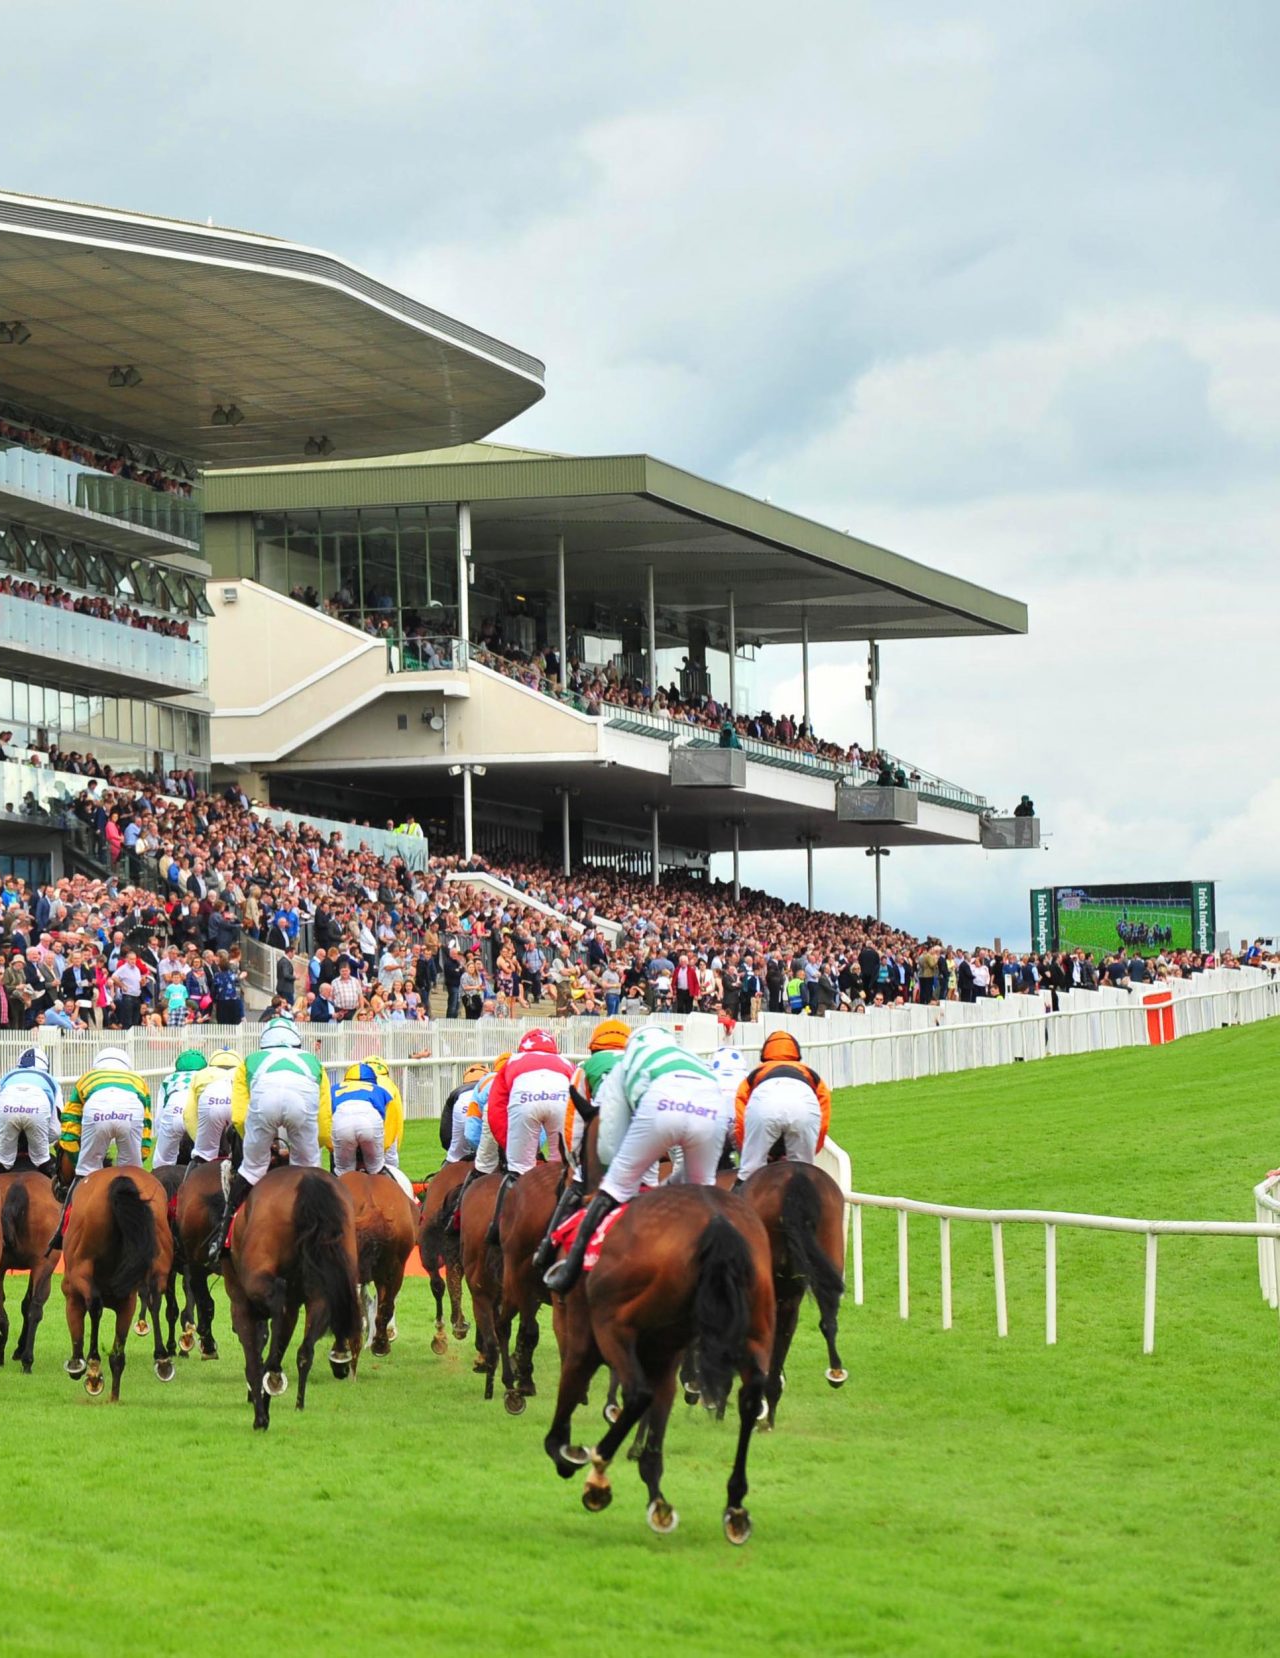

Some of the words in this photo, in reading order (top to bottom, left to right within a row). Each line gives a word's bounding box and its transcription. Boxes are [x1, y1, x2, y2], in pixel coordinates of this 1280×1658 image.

[1037, 894, 1047, 916] Irish
[1198, 887, 1208, 910] Irish
[519, 1090, 567, 1104] Stobart
[2, 1105, 40, 1115] Stobart
[93, 1111, 134, 1122] Stobart
[657, 1099, 718, 1121] Stobart
